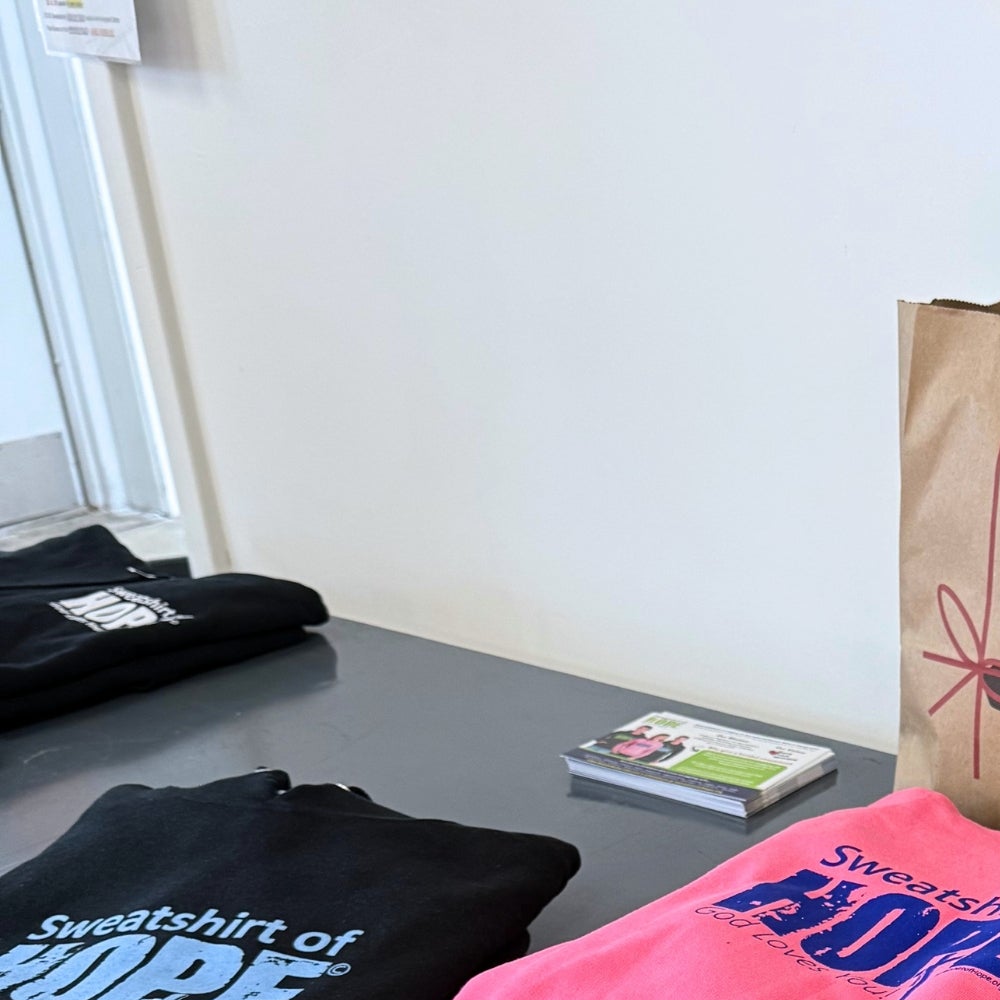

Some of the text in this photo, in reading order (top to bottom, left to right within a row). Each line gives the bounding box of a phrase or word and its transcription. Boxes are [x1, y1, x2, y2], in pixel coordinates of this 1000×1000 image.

[59, 590, 160, 630] HOP
[27, 906, 365, 958] Sweatshirt of
[695, 906, 761, 929] God
[752, 933, 829, 972] Loves
